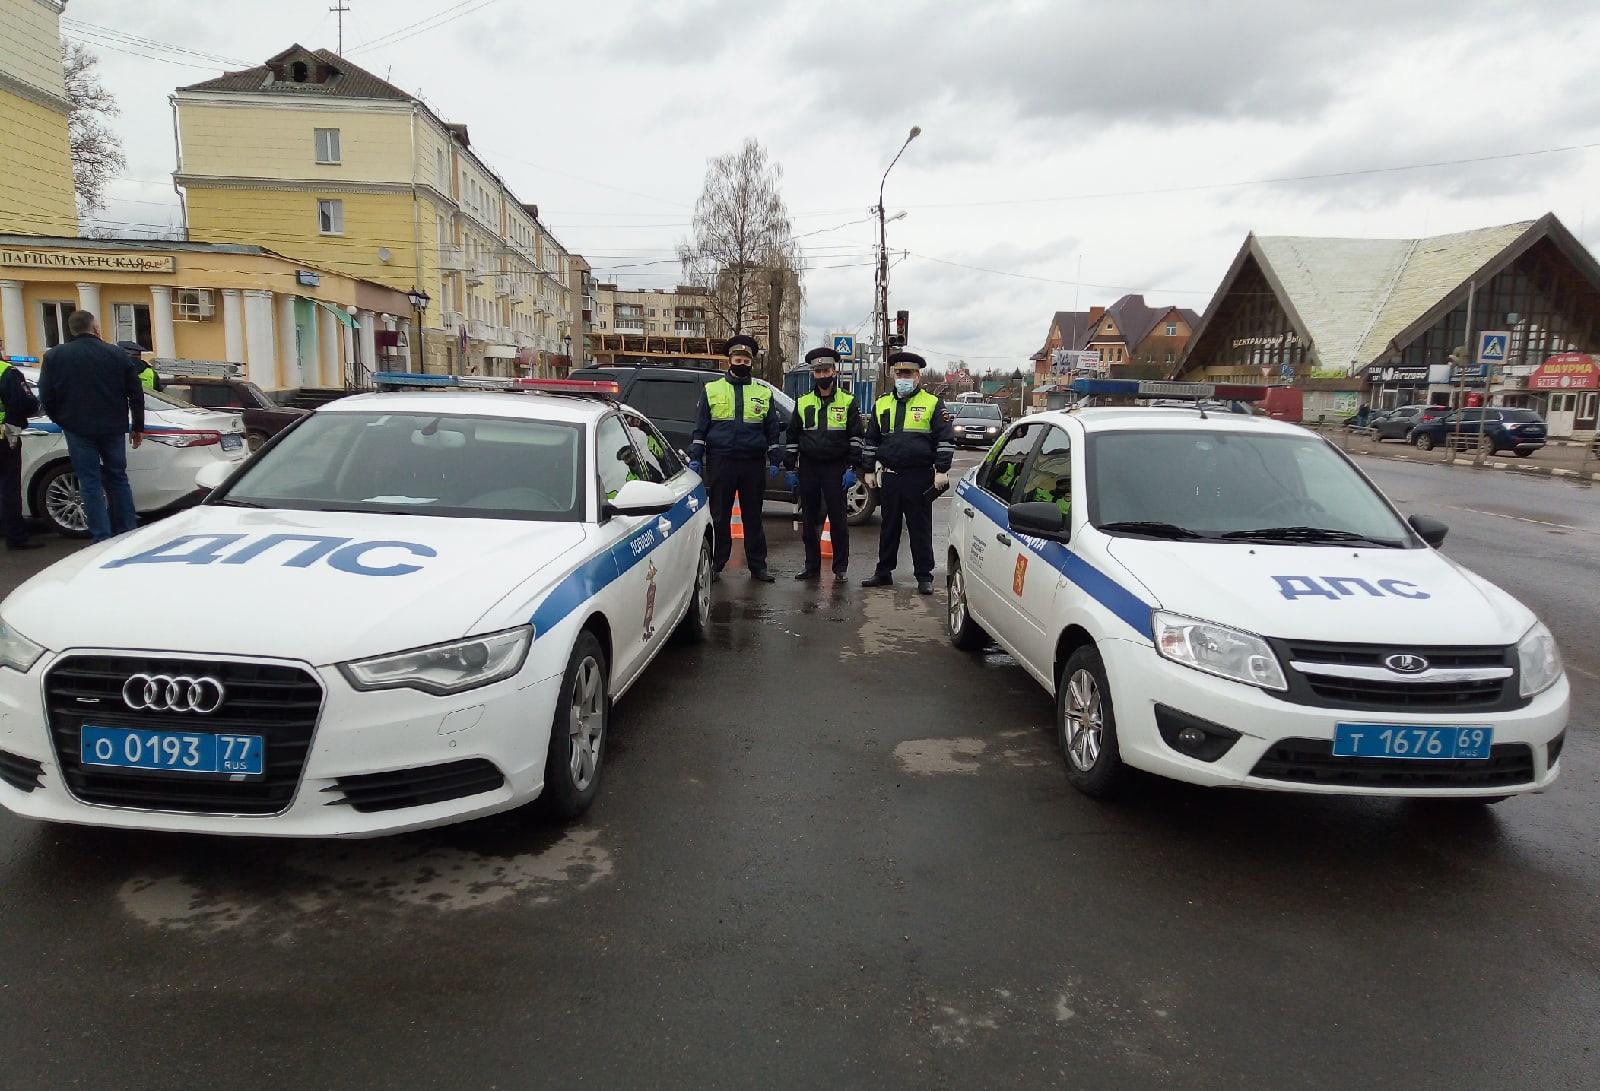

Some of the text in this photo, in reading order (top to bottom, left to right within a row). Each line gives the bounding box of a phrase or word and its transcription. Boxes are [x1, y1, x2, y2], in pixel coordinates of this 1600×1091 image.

[3, 253, 143, 270] ПАРИКМАХЕРСКАЯ
[1544, 364, 1593, 373] ШАУРМА
[99, 534, 437, 577] ДПС
[1270, 576, 1430, 600] ДПС
[95, 734, 251, 766] О 0193 77
[1350, 730, 1484, 755] Т 1676 69
[224, 762, 247, 770] RUS
